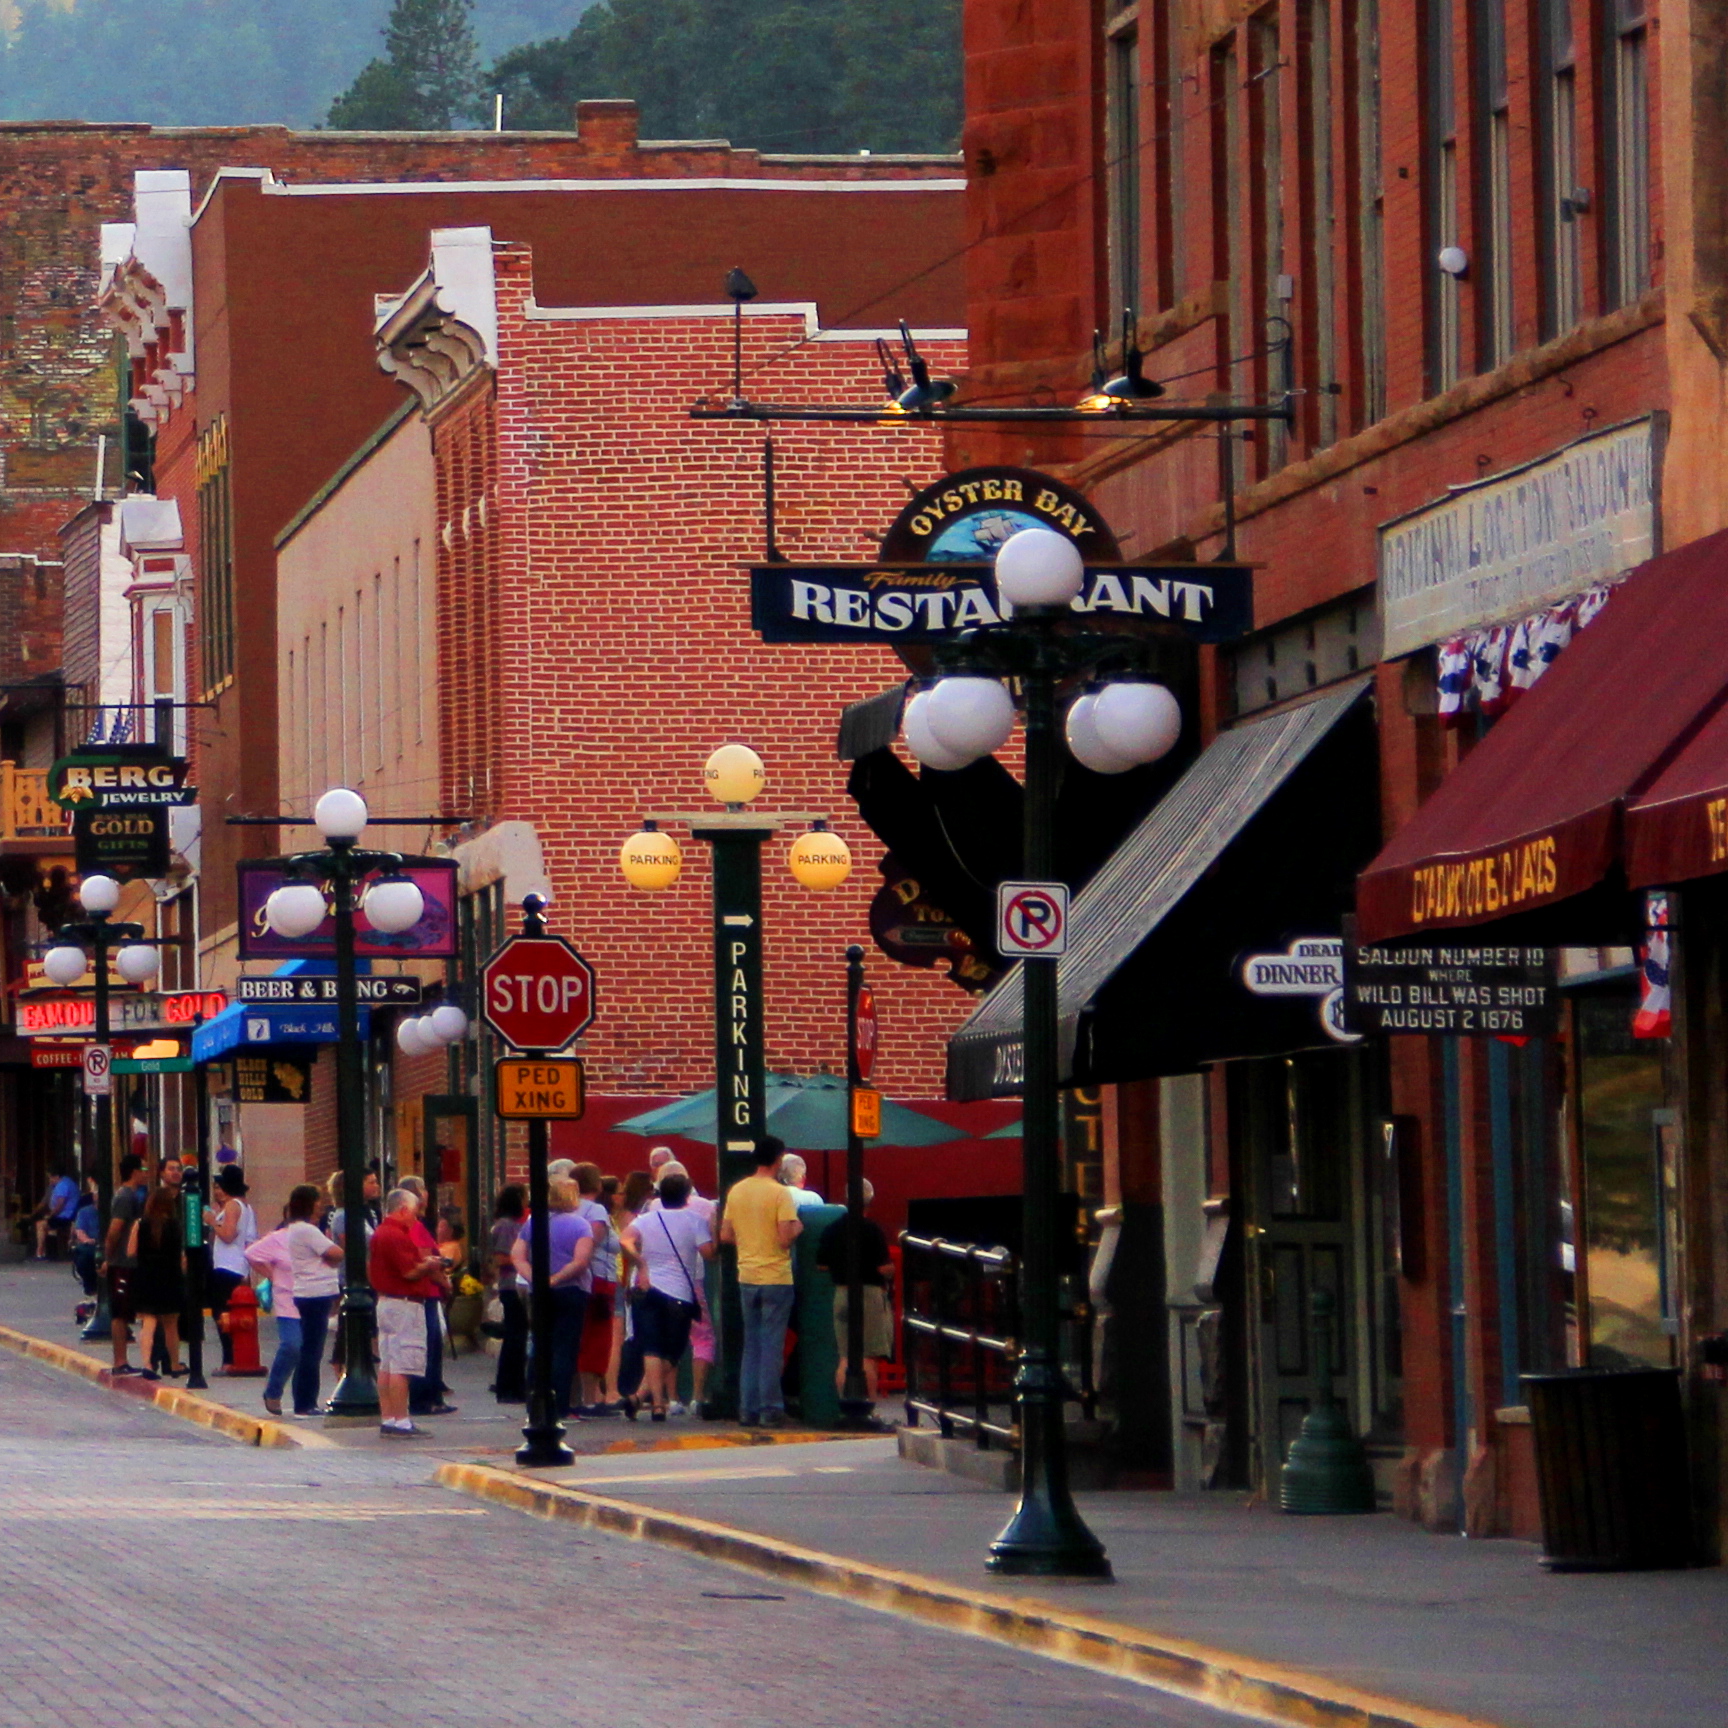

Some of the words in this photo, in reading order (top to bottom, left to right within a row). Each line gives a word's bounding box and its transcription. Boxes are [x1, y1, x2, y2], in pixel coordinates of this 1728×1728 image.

[910, 478, 1024, 537] OYSTER
[1033, 487, 1097, 539] BAY
[863, 571, 979, 591] Family
[790, 578, 1214, 634] RESTAANT
[67, 765, 175, 788] BERG
[101, 791, 185, 807] JEWELRY
[89, 819, 155, 835] GOLD
[97, 840, 149, 850] GIFTS
[629, 853, 679, 866] PARKING
[797, 853, 847, 866] PARKING
[1298, 943, 1344, 958] DEAD
[1358, 947, 1433, 965] SALOON
[1440, 948, 1520, 966] NUMBER
[1526, 949, 1545, 967] 10
[1255, 963, 1341, 985] DINNER
[1428, 969, 1474, 983] WHERE
[240, 981, 294, 999] BEER
[300, 981, 317, 999] &
[322, 980, 388, 999] BNG
[493, 973, 583, 1014] STOP
[1357, 985, 1403, 1005] WILD
[1409, 986, 1450, 1005] BILL
[1452, 986, 1492, 1006] WAS
[1498, 986, 1547, 1006] SHOT
[23, 1001, 96, 1031] FAMOU
[164, 992, 227, 1023] GOLD
[1380, 1009, 1457, 1029] AUGUST
[1462, 1010, 1475, 1028] 2
[1481, 1010, 1524, 1030] 1876
[730, 941, 751, 1126] PARKING
[36, 1055, 71, 1065] COFFEE
[141, 1060, 161, 1071] Gold
[517, 1067, 561, 1085] PED
[515, 1090, 566, 1110] XING
